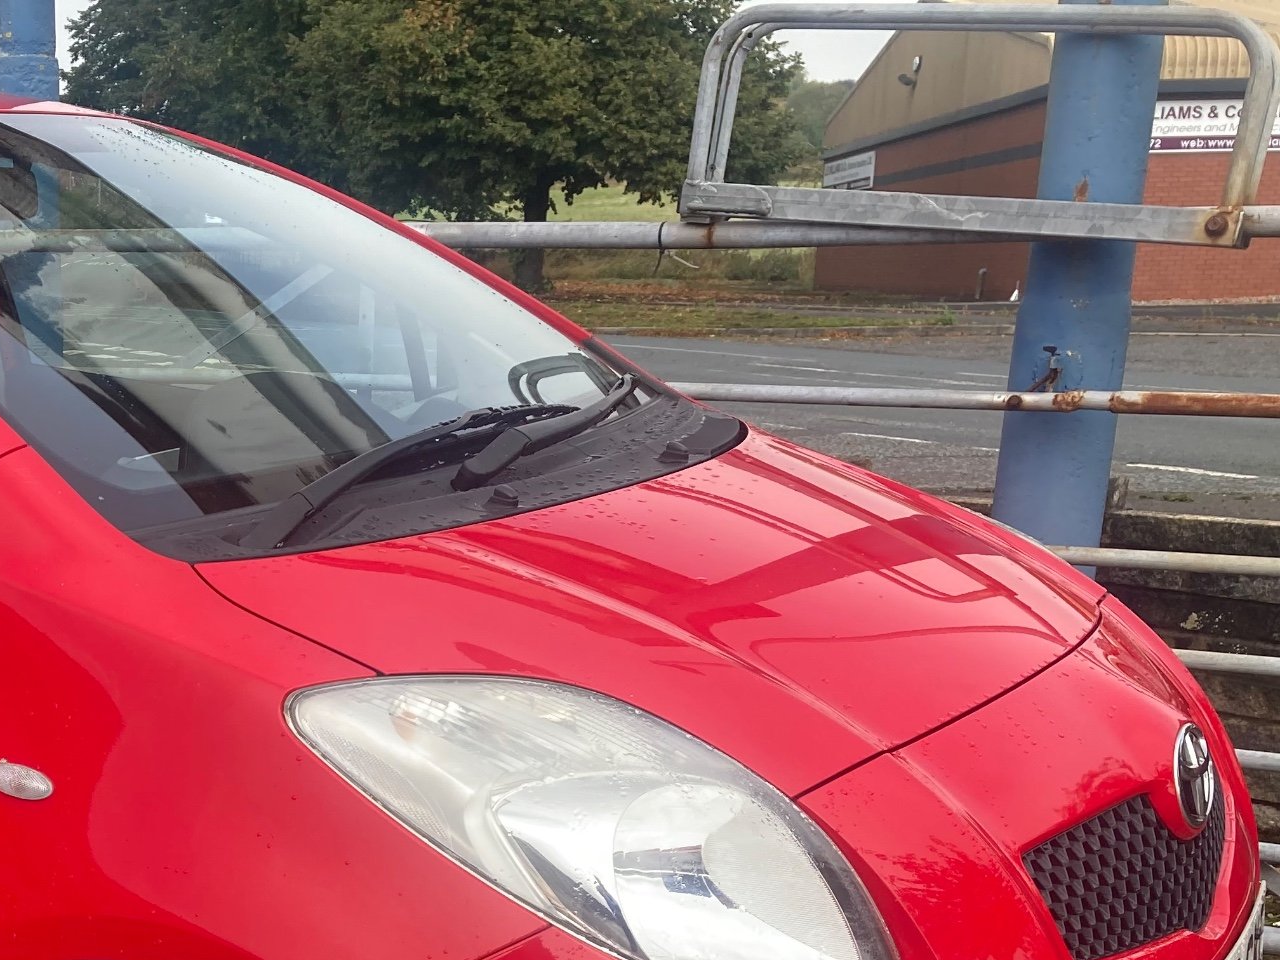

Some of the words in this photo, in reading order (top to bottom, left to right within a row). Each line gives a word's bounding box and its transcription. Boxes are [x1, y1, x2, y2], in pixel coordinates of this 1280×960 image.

[1207, 105, 1219, 119] &
[1154, 123, 1202, 134] ngineers
[1204, 123, 1227, 132] and
